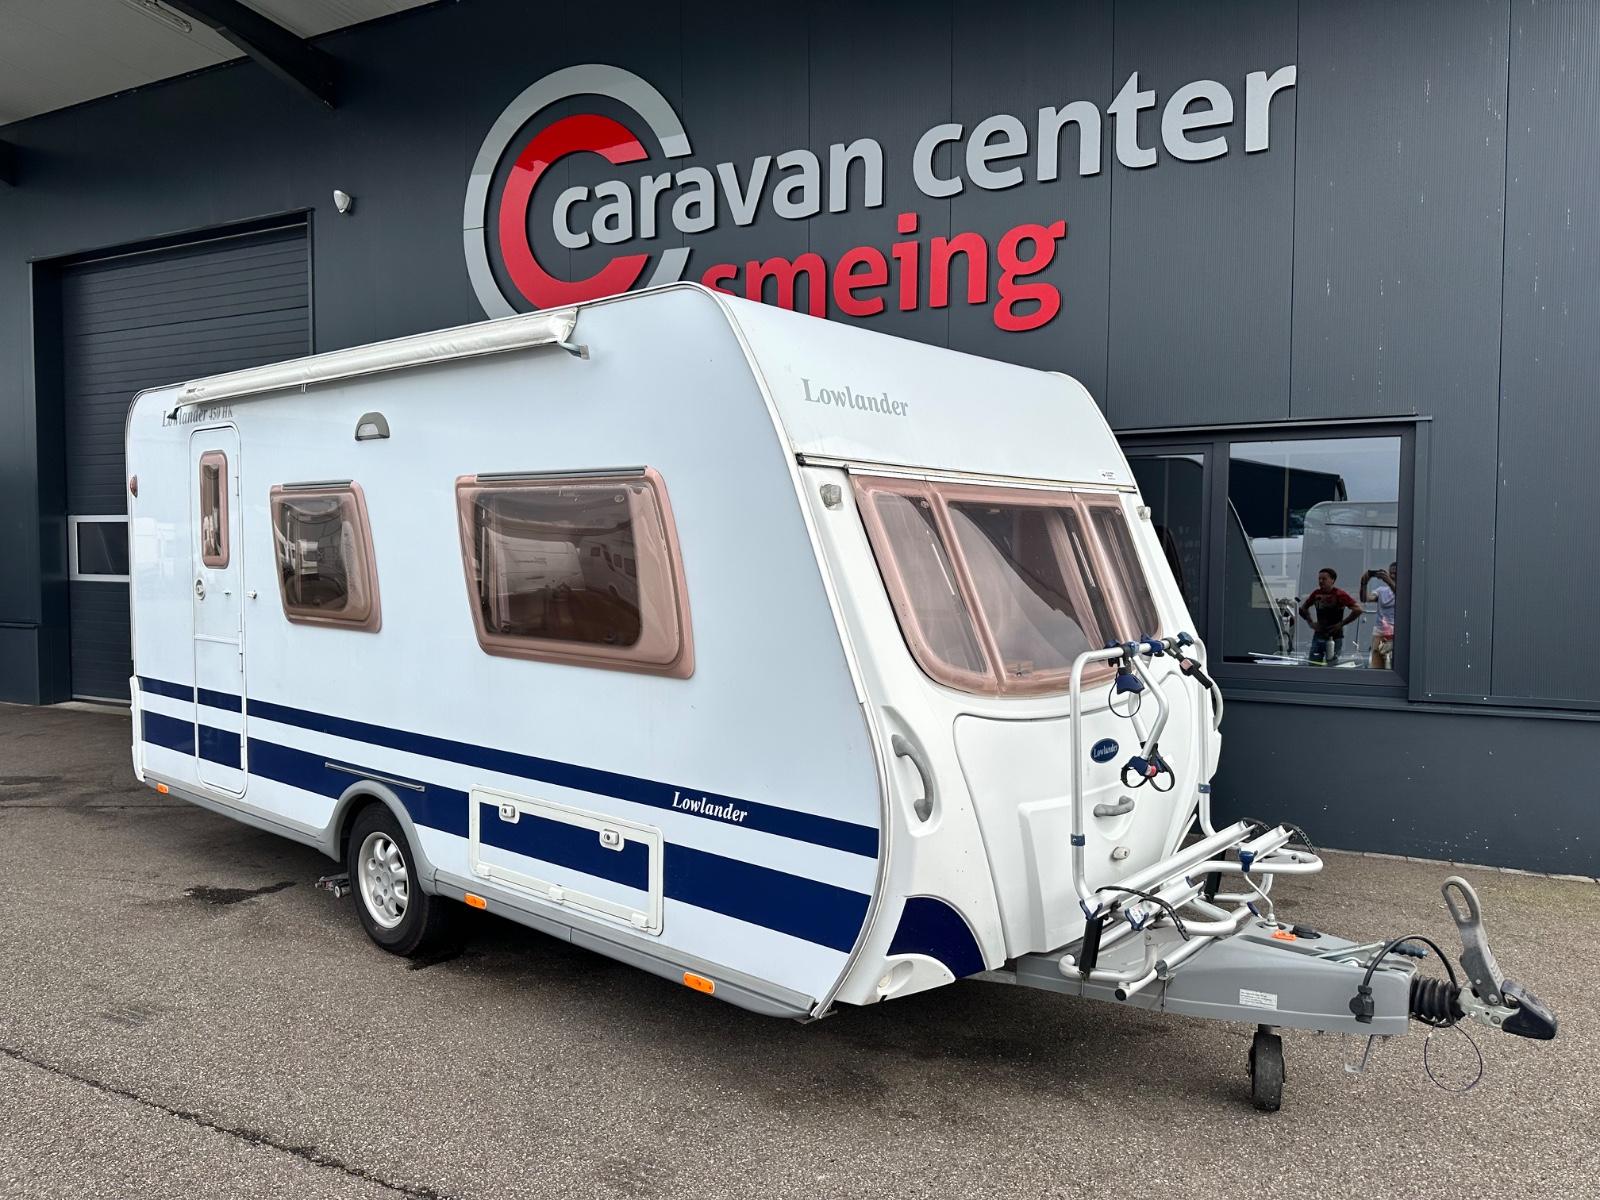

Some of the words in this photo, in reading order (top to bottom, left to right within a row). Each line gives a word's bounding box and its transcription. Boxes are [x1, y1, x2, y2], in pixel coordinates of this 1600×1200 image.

[552, 137, 884, 249] caravan
[912, 64, 1297, 198] center
[801, 377, 909, 417] Lowlander
[1093, 743, 1119, 759] Lowlander
[671, 791, 748, 822] Lowlander
